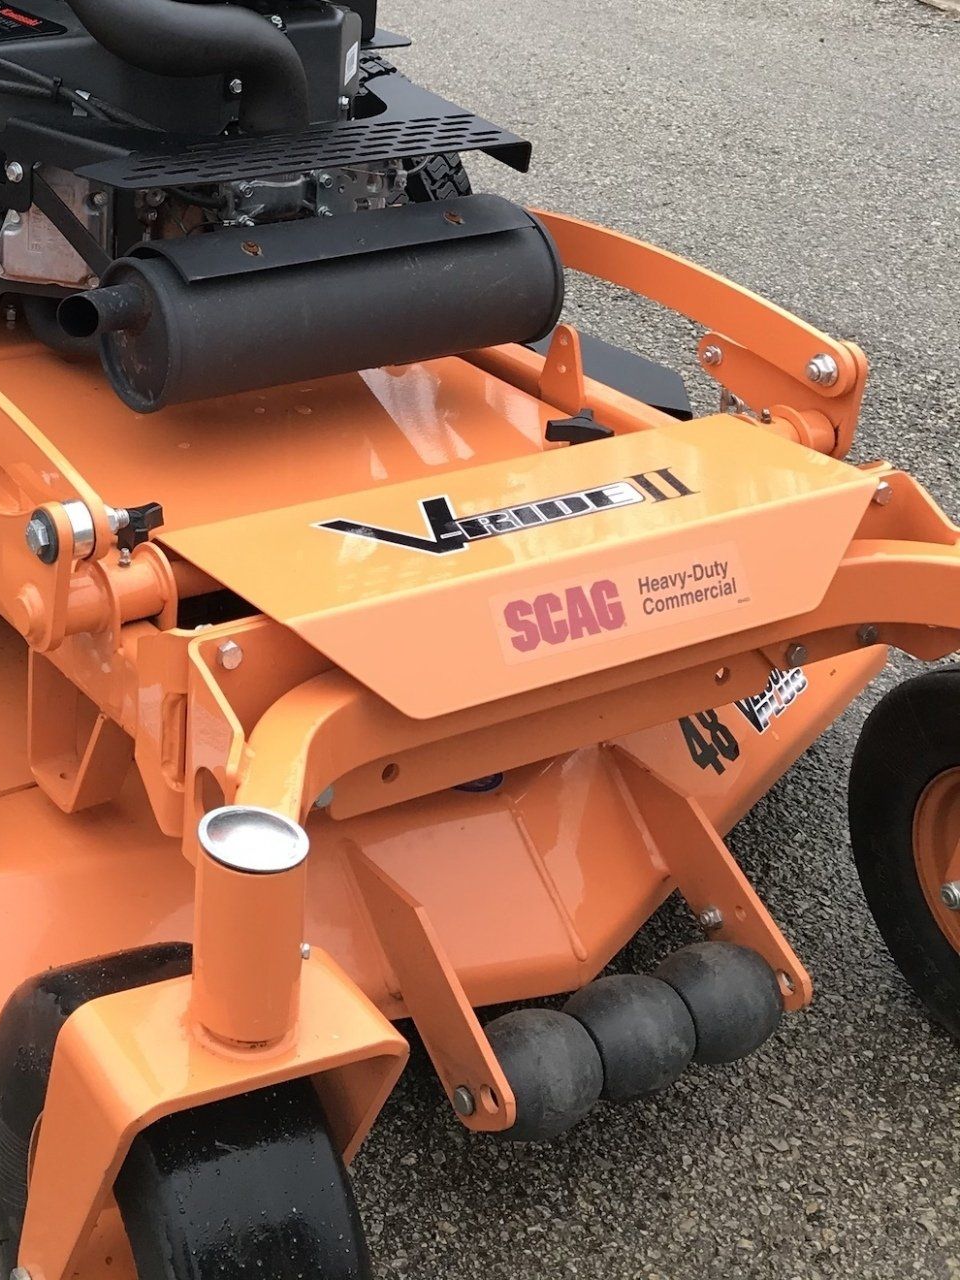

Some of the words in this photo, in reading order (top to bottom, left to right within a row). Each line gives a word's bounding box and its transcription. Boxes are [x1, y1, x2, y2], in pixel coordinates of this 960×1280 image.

[638, 560, 728, 595] Heavy-Duty
[642, 577, 737, 615] Commercial
[503, 579, 626, 653] SCAG
[755, 668, 808, 729] PLUS
[678, 709, 740, 776] 48
